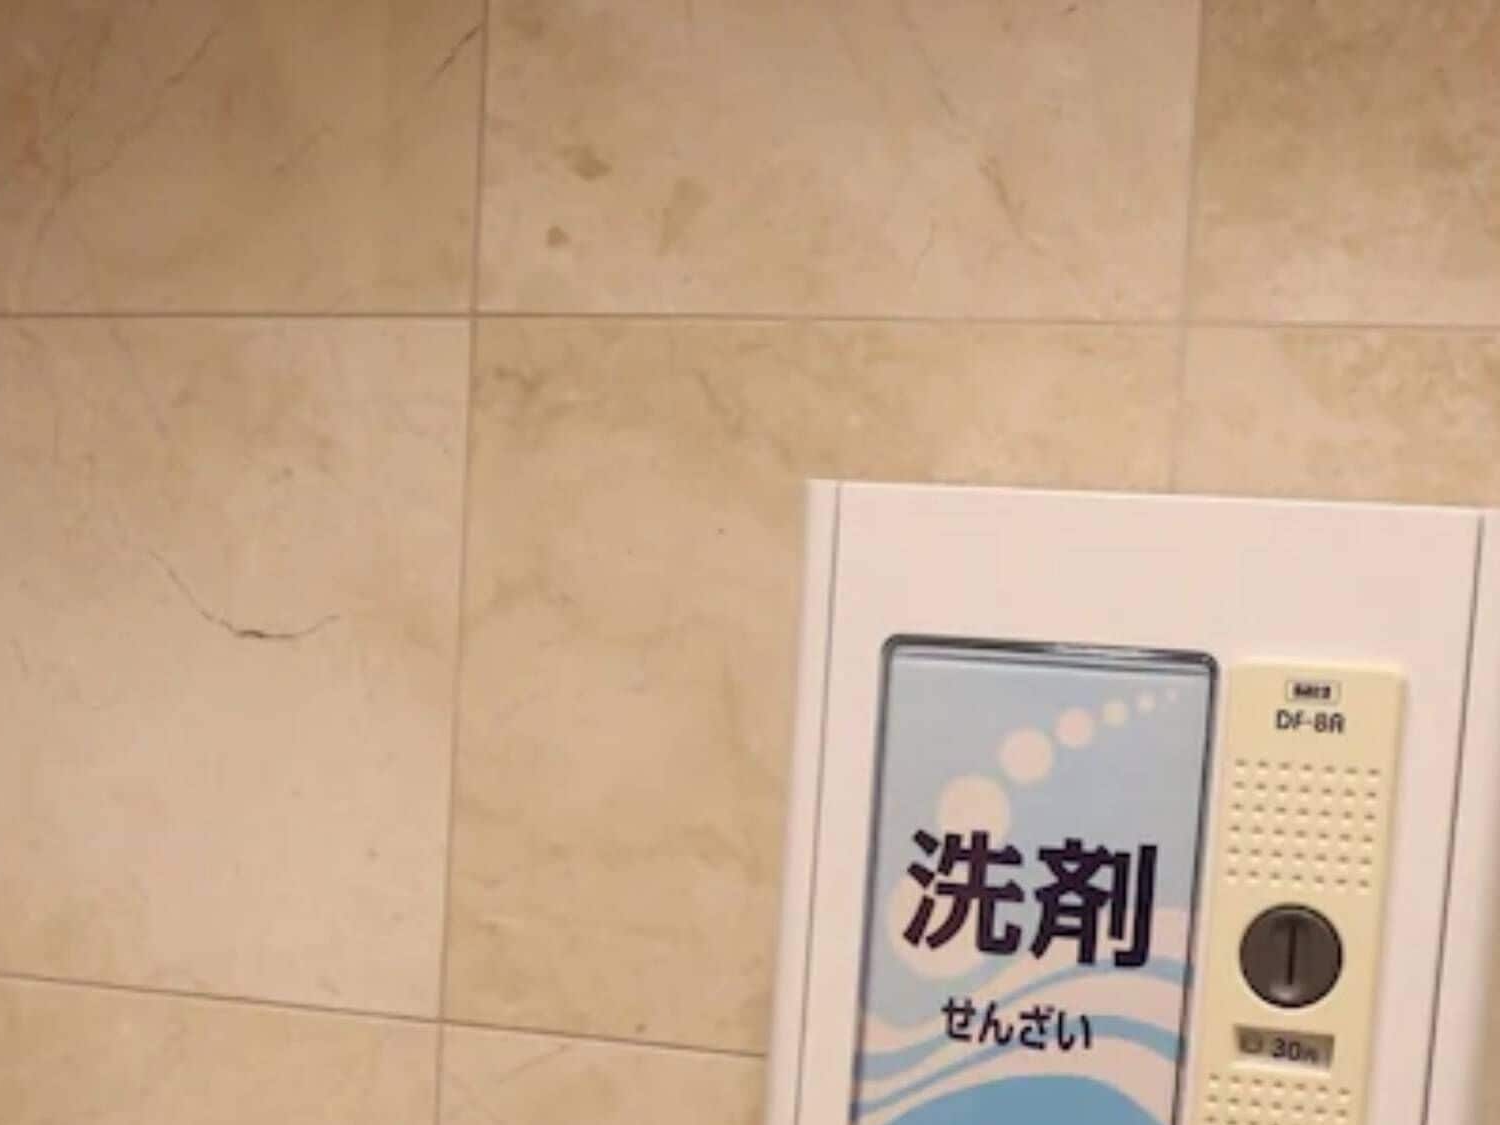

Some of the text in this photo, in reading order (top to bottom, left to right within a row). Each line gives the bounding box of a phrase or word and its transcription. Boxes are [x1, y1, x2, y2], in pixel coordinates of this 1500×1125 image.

[1275, 708, 1346, 734] DF-8A
[902, 828, 1158, 969] 洗剤
[941, 997, 1092, 1052] せんざい
